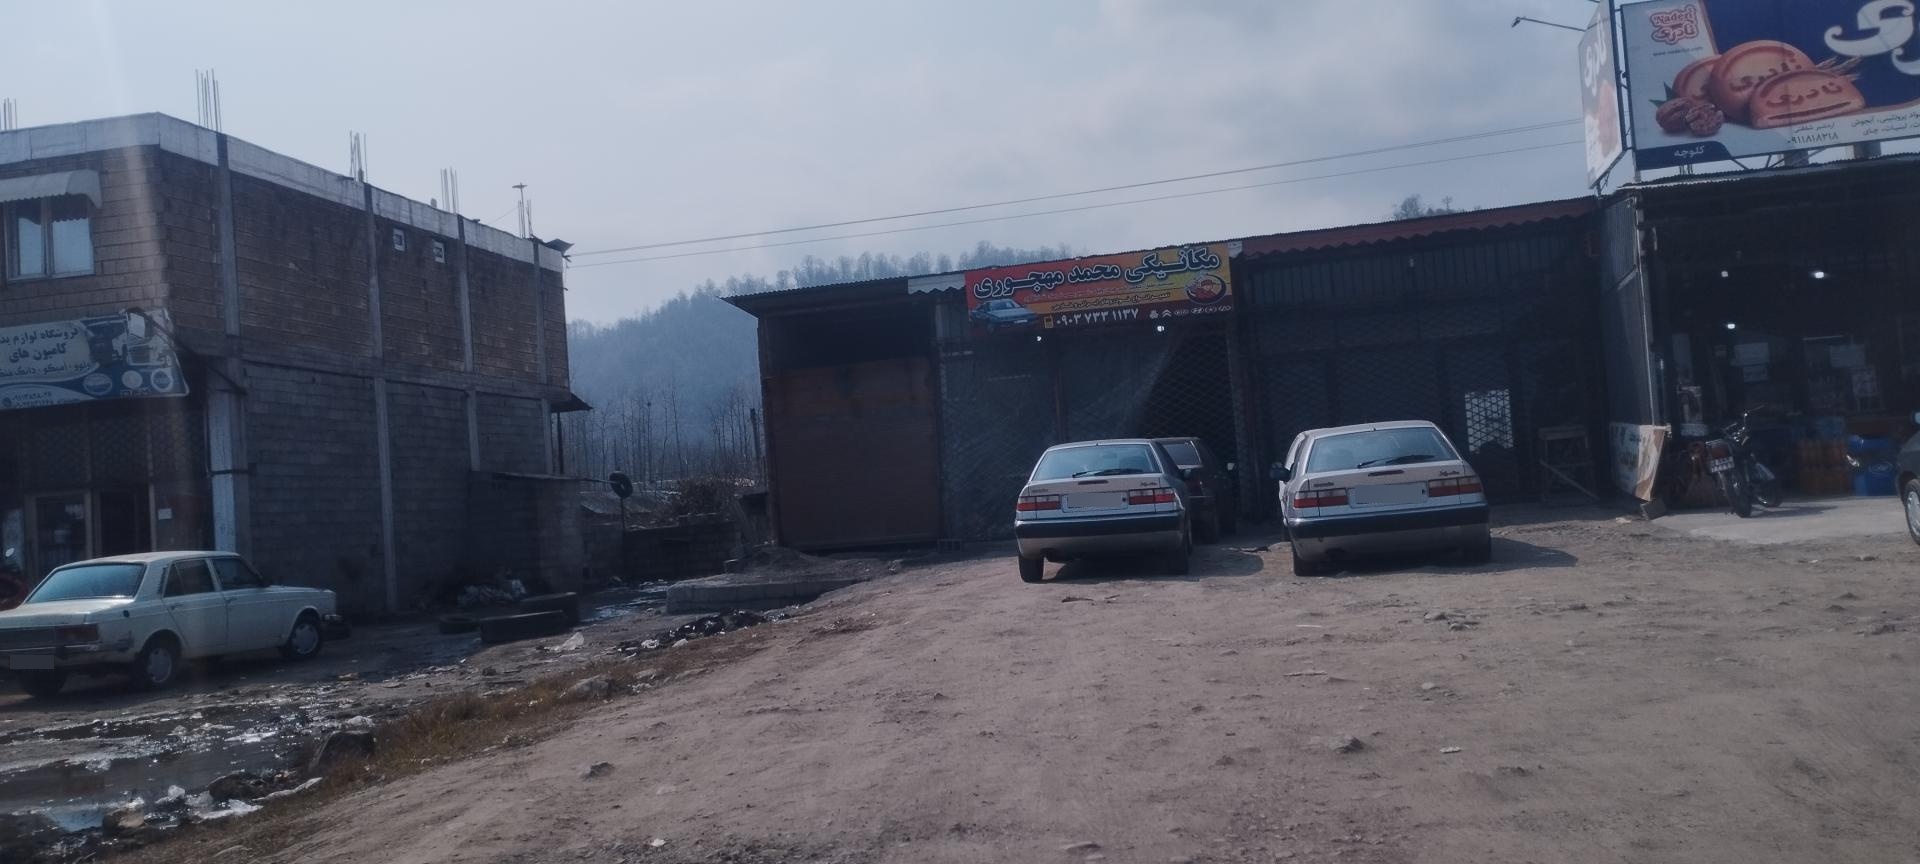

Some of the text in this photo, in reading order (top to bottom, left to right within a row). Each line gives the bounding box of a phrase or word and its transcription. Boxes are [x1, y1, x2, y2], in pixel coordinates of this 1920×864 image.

[1653, 8, 1697, 26] Naderi
[1654, 22, 1696, 42] نادری
[1765, 81, 1844, 108] نادری
[1673, 144, 1705, 160] کلوچه
[1068, 264, 1121, 284] محمد
[1125, 248, 1220, 283] مکانیکی
[973, 271, 1064, 299] مهجوری
[1056, 308, 1139, 326] ۰۹۰۳ ۷۳۳ ۱۱۳۷
[14, 331, 39, 345] لوازم
[40, 327, 79, 341] فروشگاه
[9, 342, 66, 363] کامیون های
